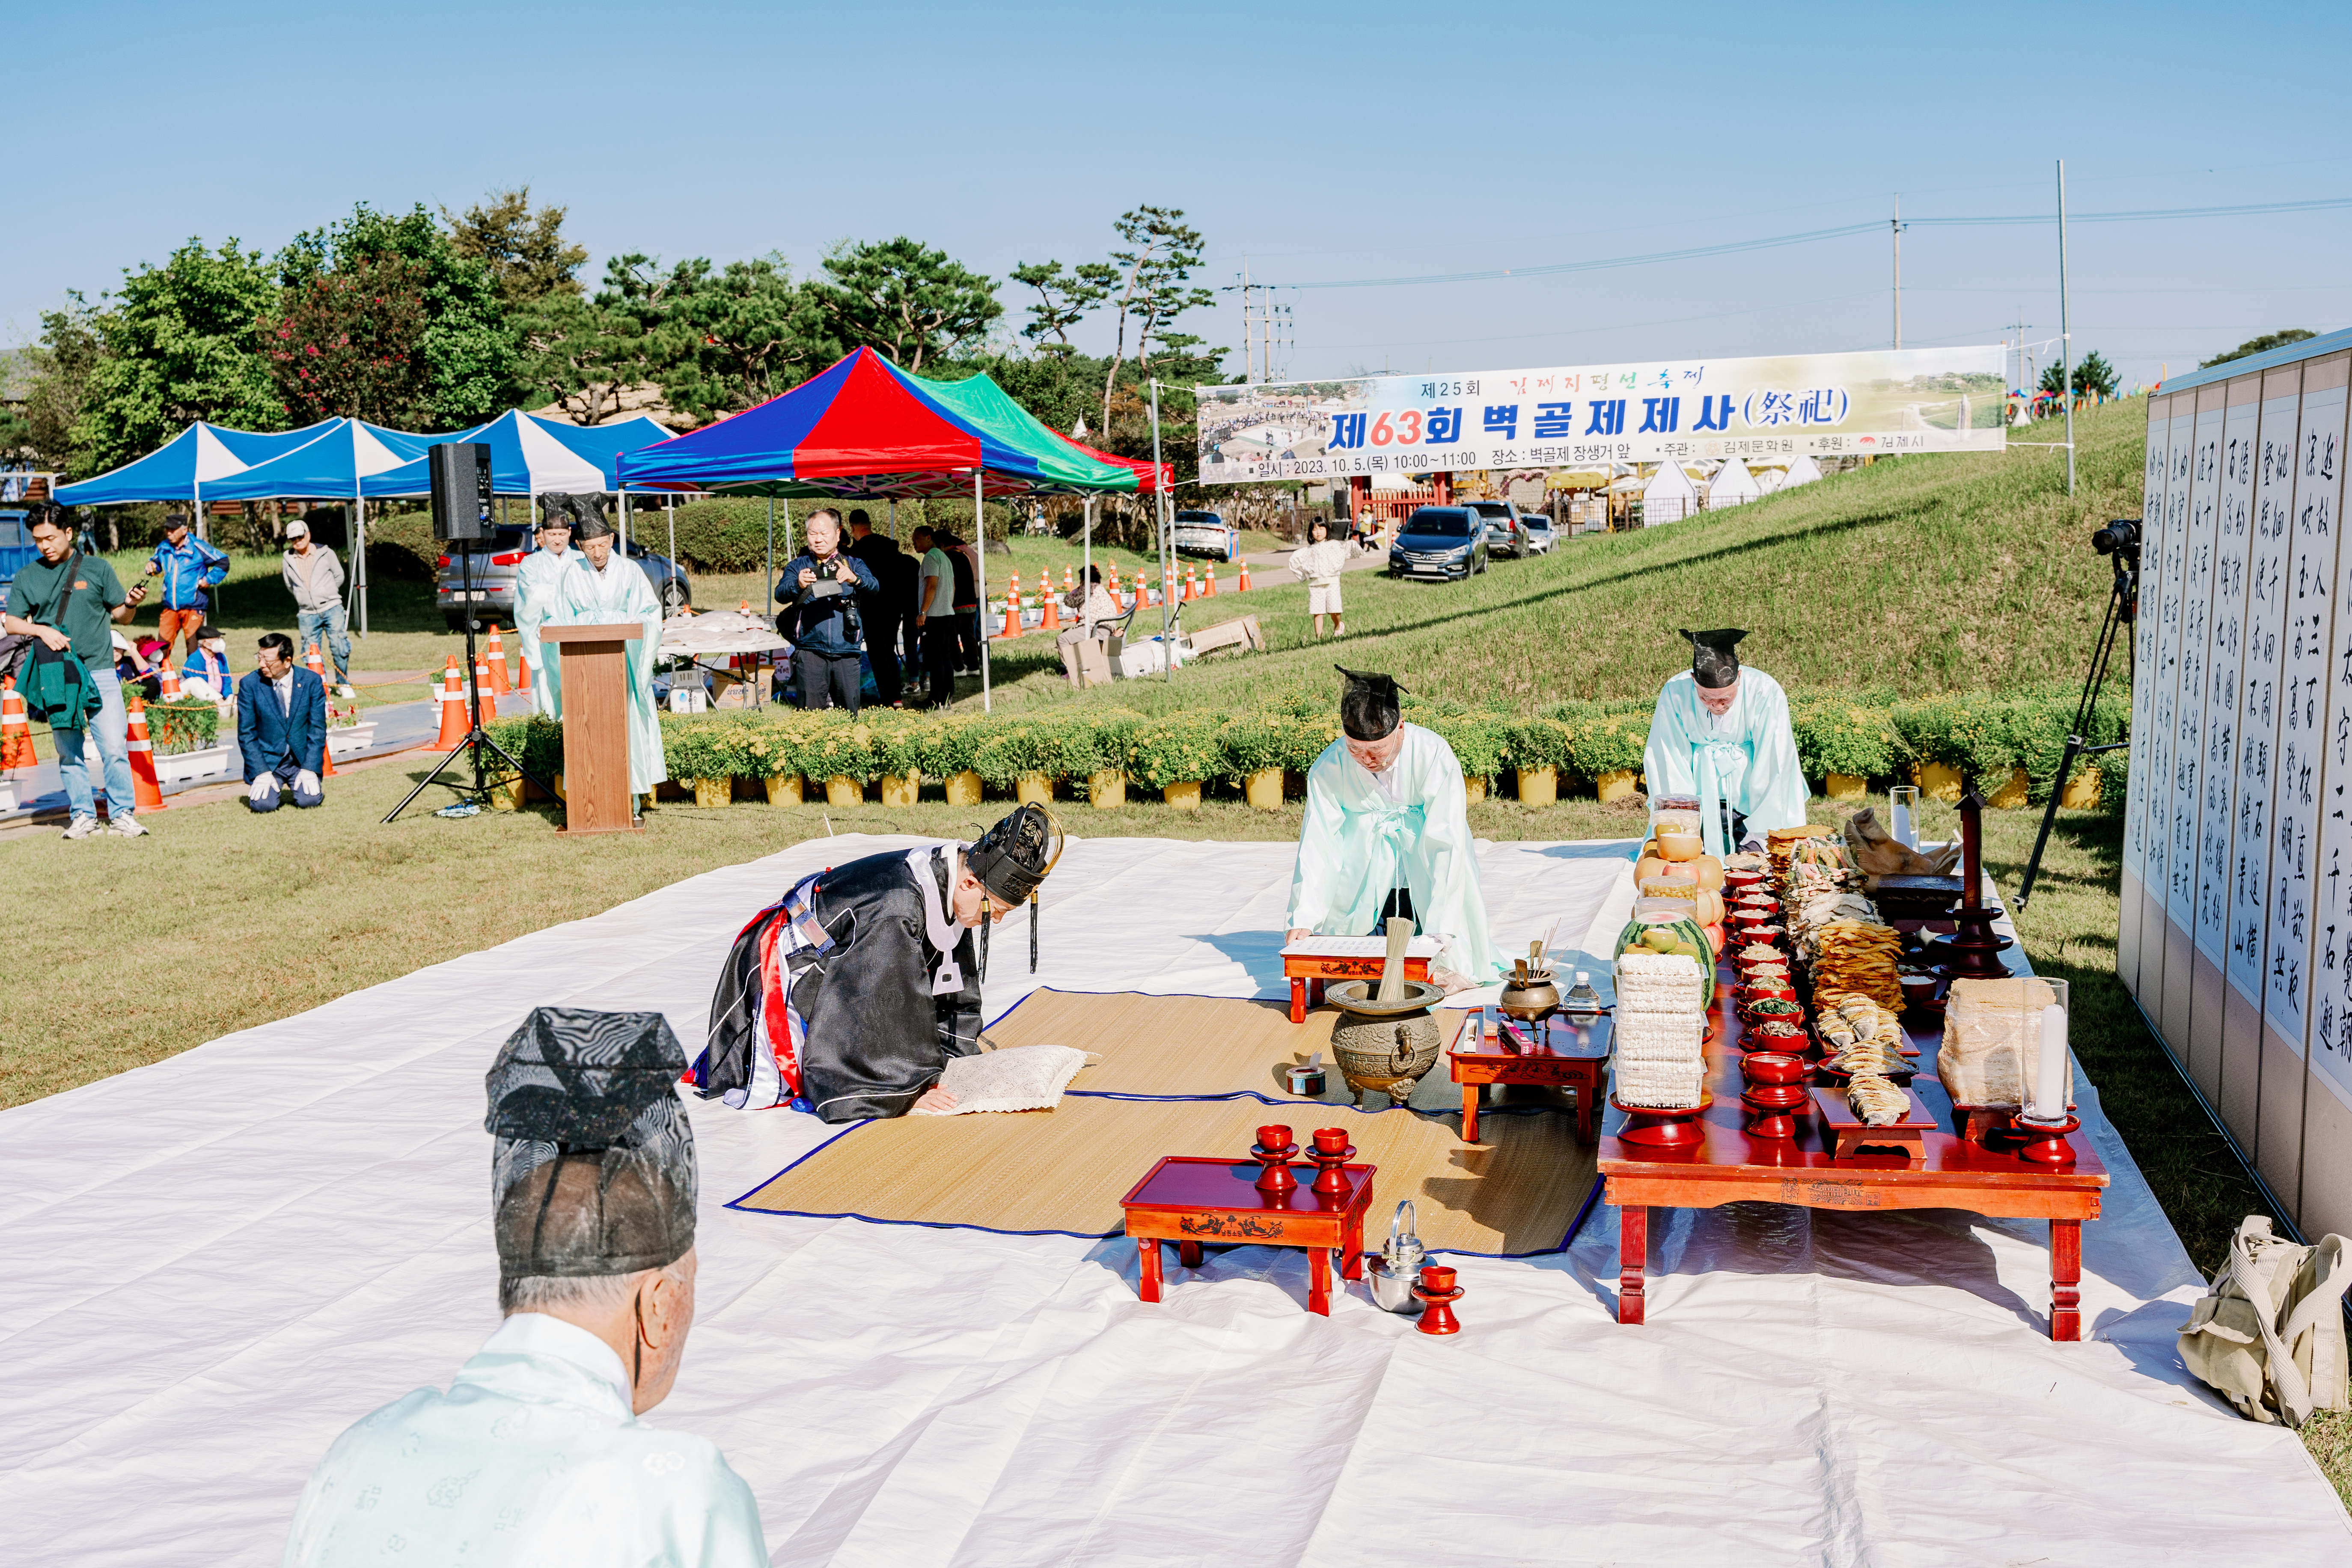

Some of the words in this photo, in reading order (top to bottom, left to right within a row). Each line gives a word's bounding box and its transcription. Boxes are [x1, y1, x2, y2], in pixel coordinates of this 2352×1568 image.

[1328, 406, 1463, 450] 제63회
[1258, 461, 1282, 477] 일시
[1294, 459, 1327, 474] 2023.
[1332, 458, 1350, 472] 10.
[1355, 455, 1388, 471] 5.(목)
[1492, 449, 1518, 465] 장소
[1531, 446, 1569, 463] 벽골제
[1574, 444, 1612, 461] 장생거
[1618, 443, 1630, 459] 앞
[1664, 443, 1688, 456] 주관
[1724, 439, 1793, 453] 김제문화원
[1818, 437, 1843, 451] 후원
[1882, 436, 1924, 448] 김제시
